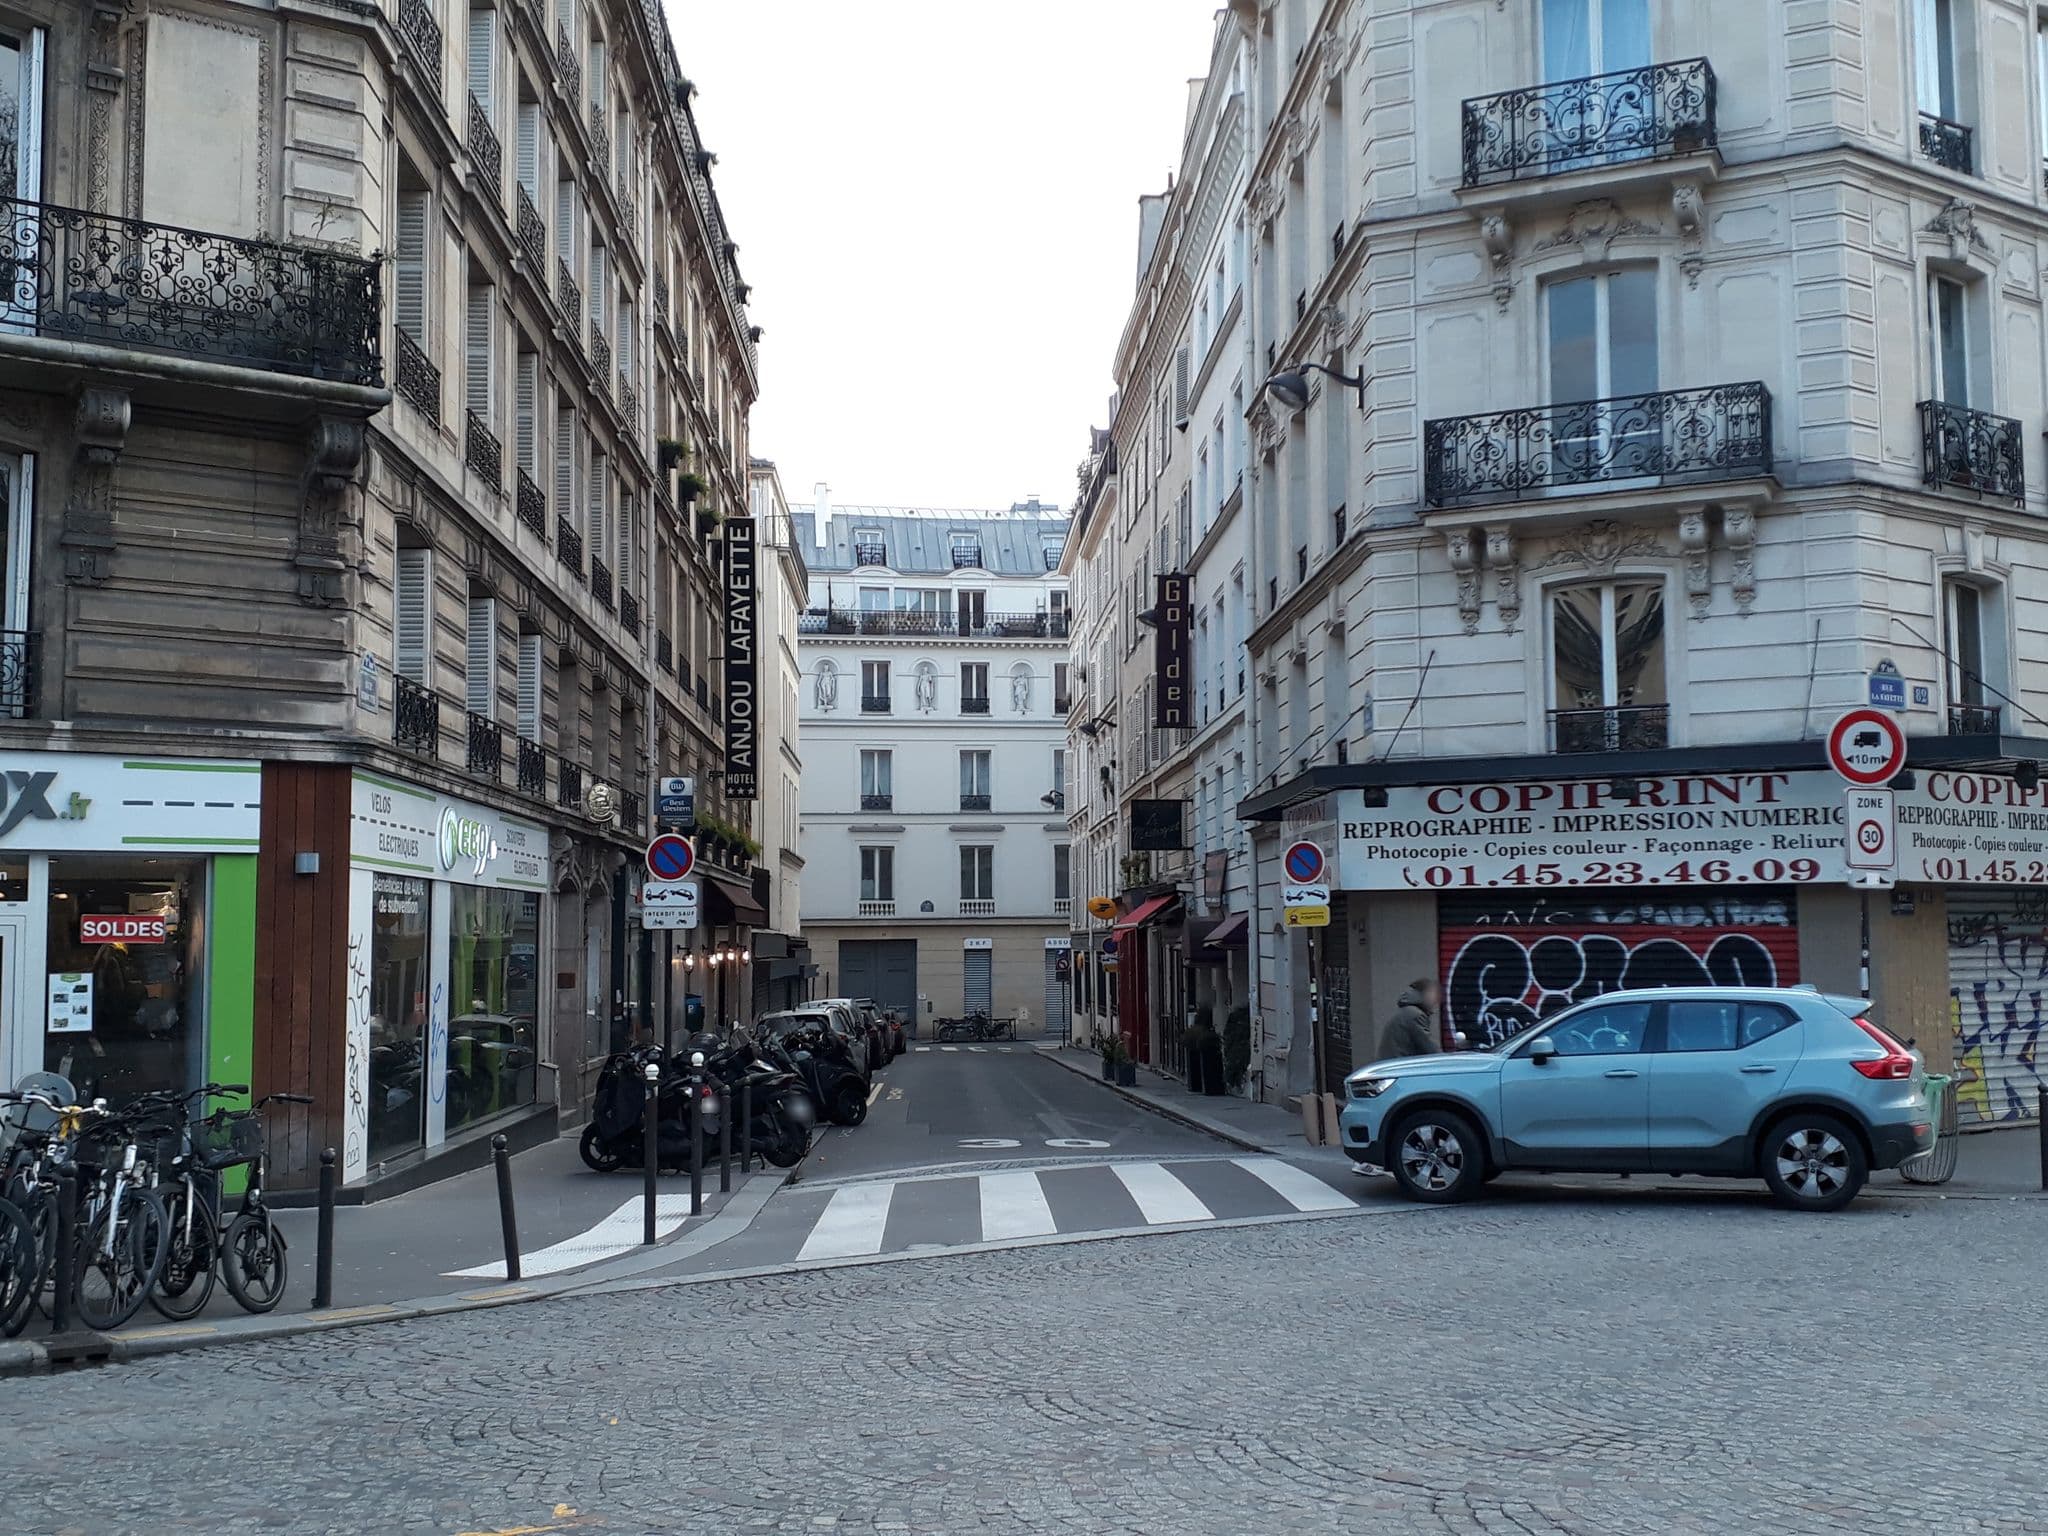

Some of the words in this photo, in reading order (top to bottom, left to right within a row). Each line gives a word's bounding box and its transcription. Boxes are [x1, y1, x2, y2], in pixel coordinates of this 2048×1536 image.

[729, 525, 751, 665] LAFAYETTE
[1165, 579, 1181, 724] Golden
[730, 680, 752, 767] ANJOU
[727, 773, 755, 785] HOTEL
[371, 791, 392, 814] VELOS
[1427, 774, 1790, 815] COPIPRINT
[1857, 797, 1884, 809] ZONE
[1342, 816, 1533, 840] REPROGRAPHIE
[1552, 810, 1715, 833] IMPRESSION
[1897, 805, 1999, 829] REPROGRAPHIE
[378, 832, 419, 859] ELECTRIQUES
[1367, 843, 1468, 861] Photocopie
[1484, 842, 1547, 859] Copies
[1553, 839, 1627, 855] couleur
[1644, 838, 1753, 856] Façonnage
[1863, 831, 1879, 844] 30
[1912, 832, 1967, 853] Photocopie
[1974, 835, 2006, 855] Copies
[2008, 837, 2043, 853] couleur
[1424, 858, 1821, 887] 01.45.23.46.09
[1936, 857, 2048, 883] 01.45.2
[83, 921, 165, 937] SOLDES
